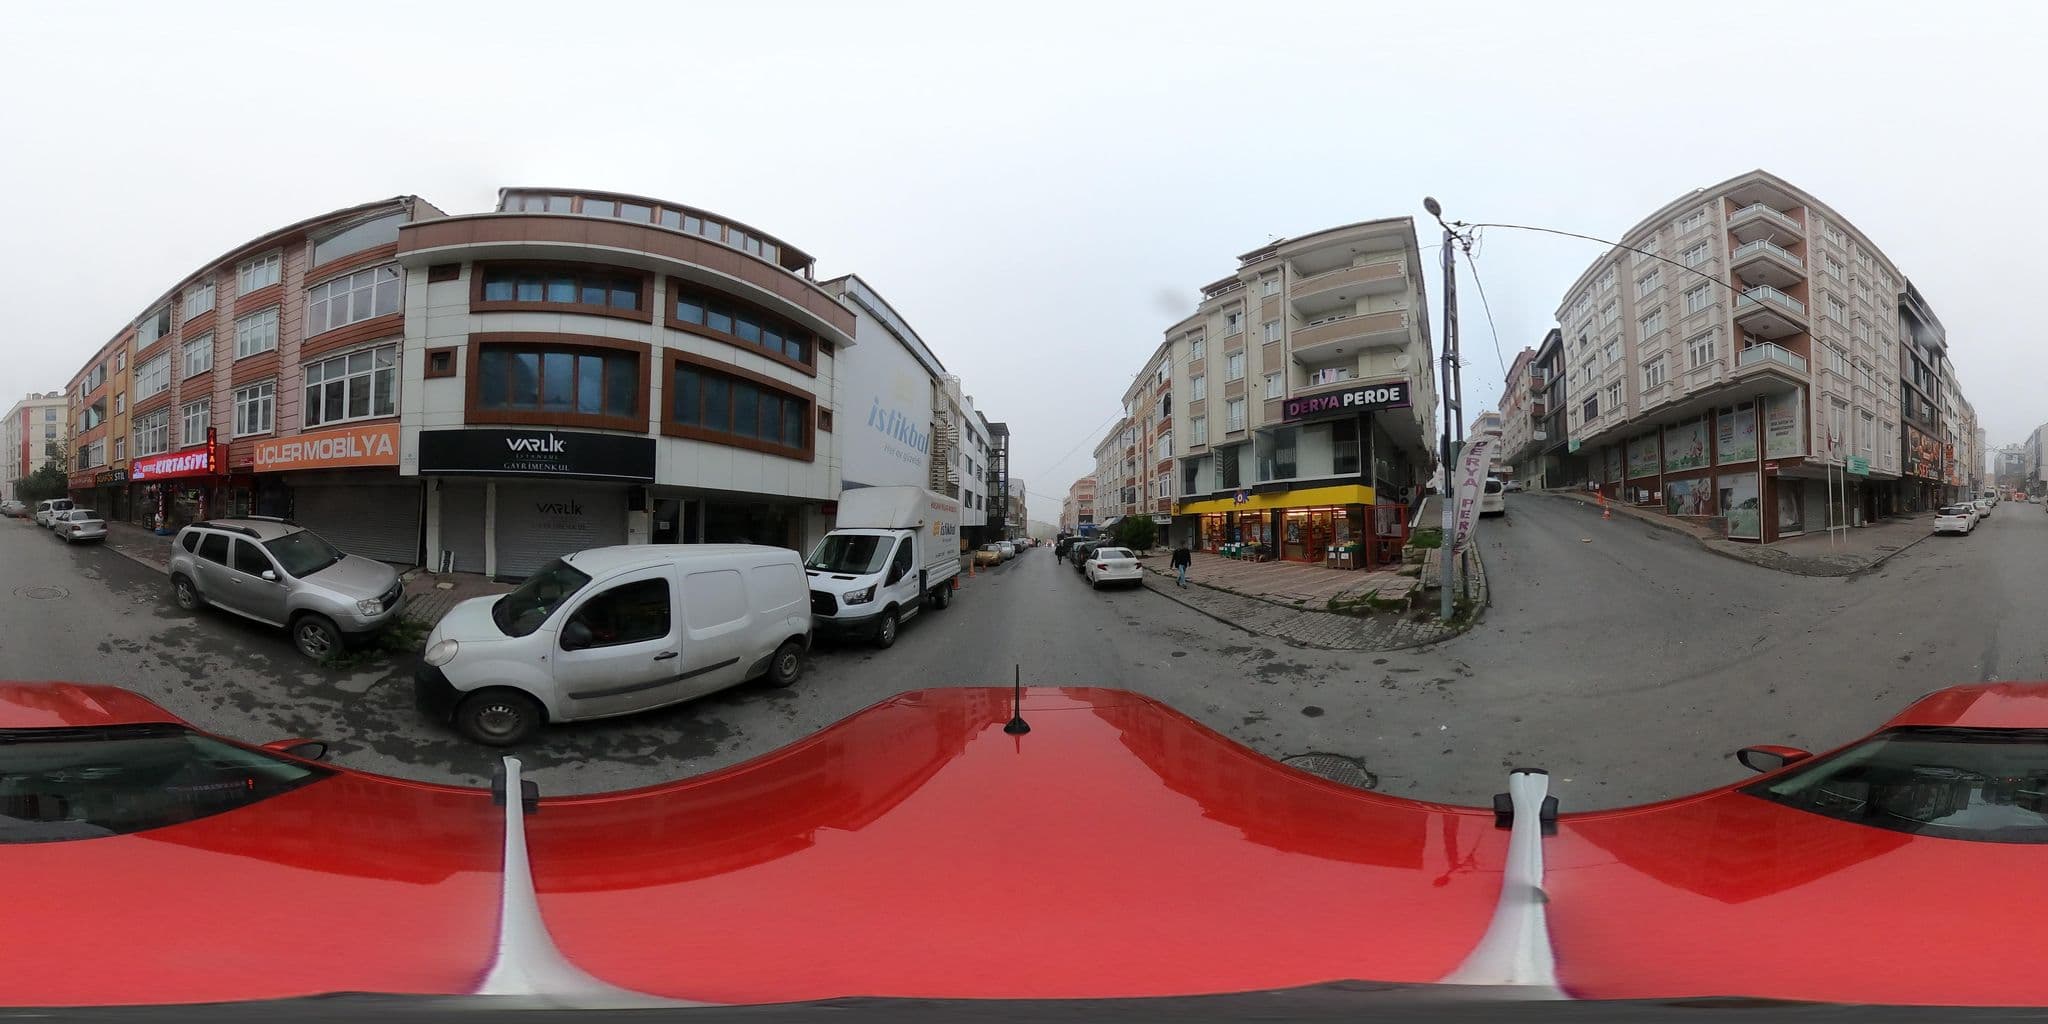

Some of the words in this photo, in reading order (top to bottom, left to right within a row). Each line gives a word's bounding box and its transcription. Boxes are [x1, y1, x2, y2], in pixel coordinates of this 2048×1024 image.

[1290, 395, 1340, 416] DERYA
[1343, 387, 1400, 407] PERDE
[868, 395, 930, 455] istikbal
[256, 443, 302, 468] ÜÇLER
[303, 432, 394, 461] MOBİLYA
